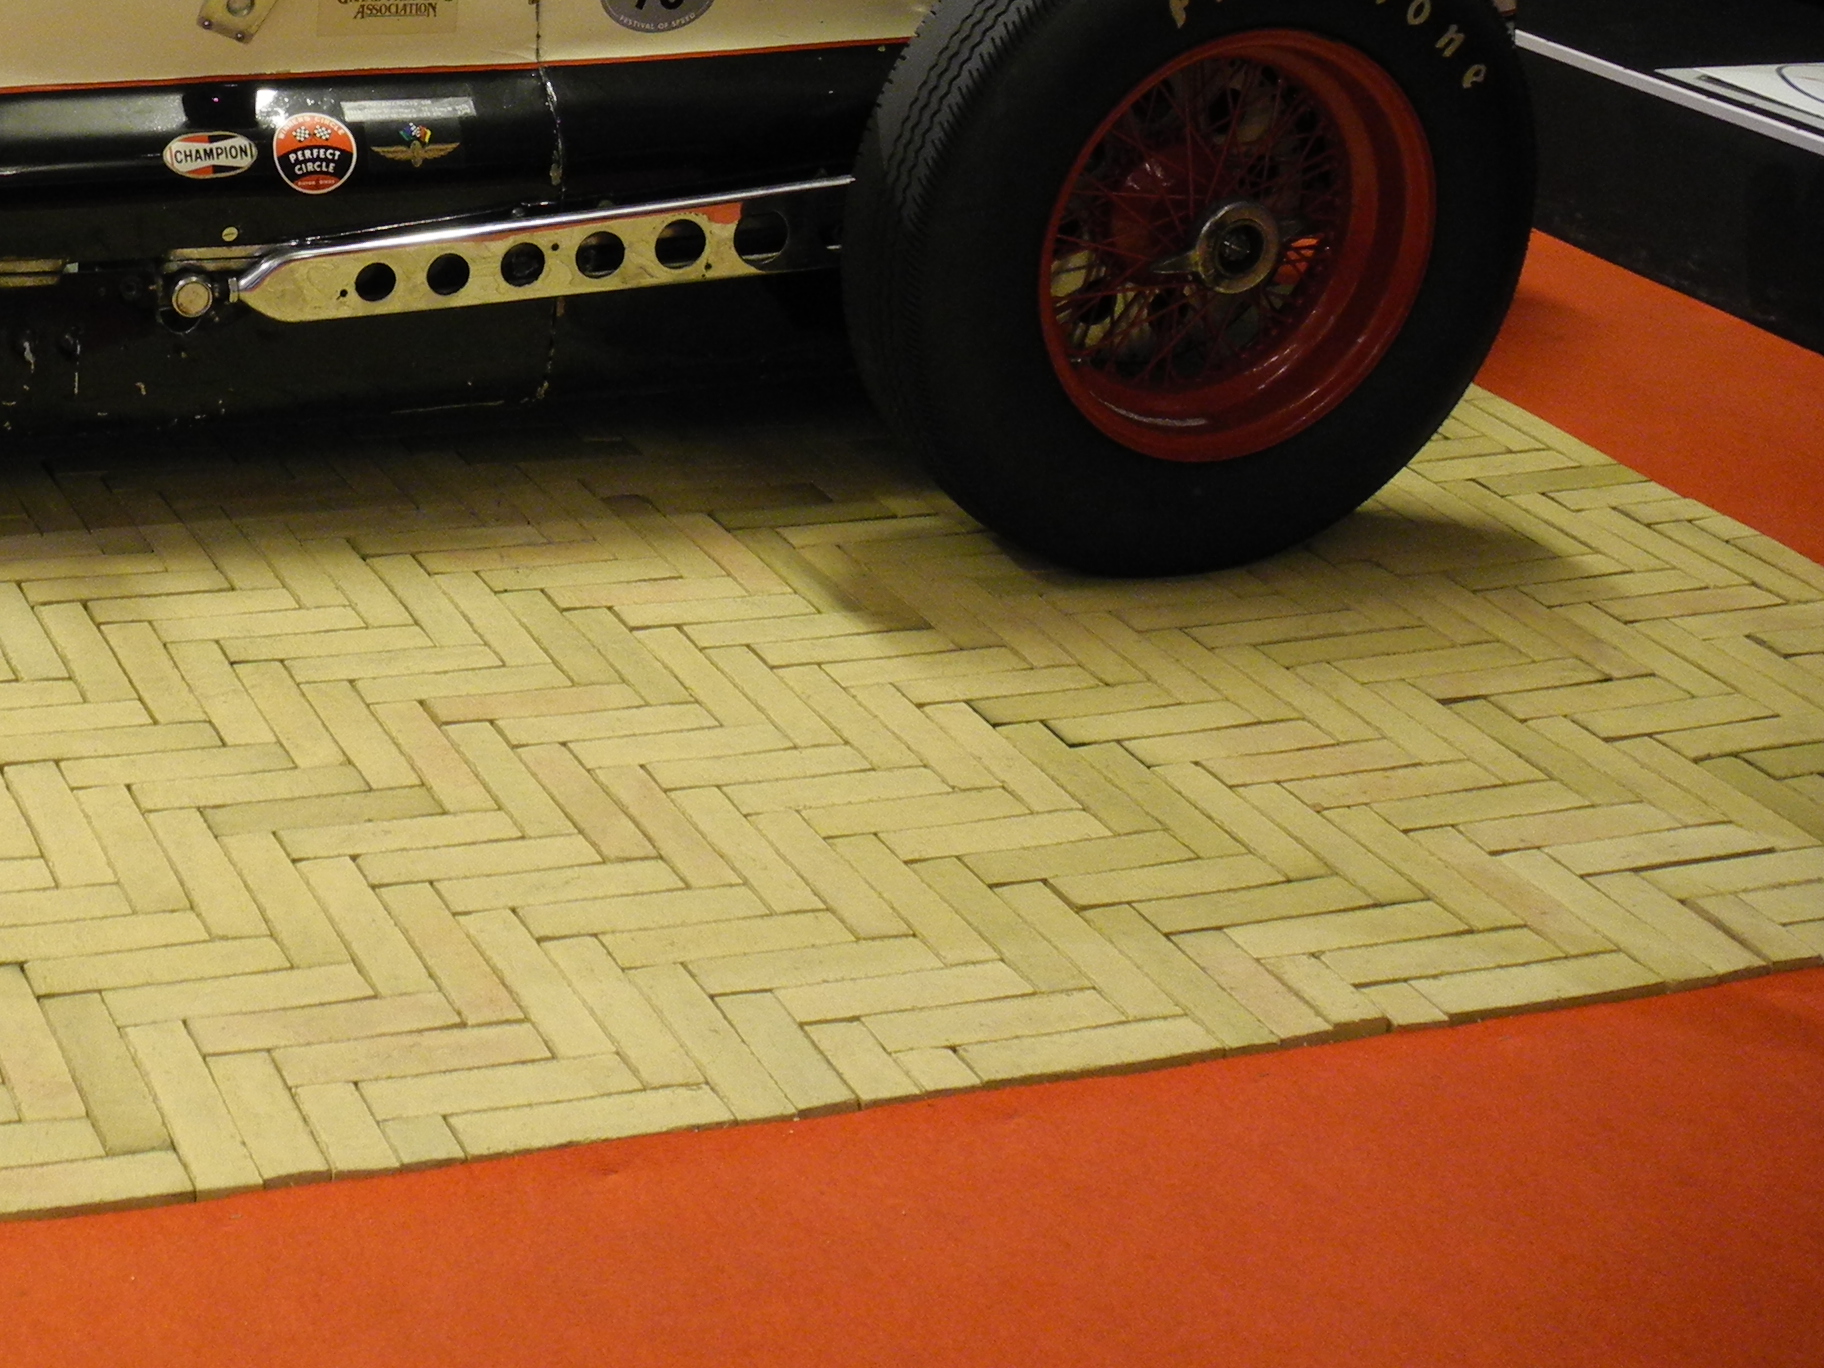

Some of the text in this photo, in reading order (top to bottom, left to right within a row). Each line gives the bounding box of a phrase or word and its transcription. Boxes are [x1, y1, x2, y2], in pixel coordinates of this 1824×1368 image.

[353, 2, 438, 19] ASSOCIATION
[619, 12, 696, 30] FESTIVAL OF SPEED
[174, 144, 249, 164] CHAMPION
[288, 148, 341, 164] PERFECT
[294, 161, 336, 175] CIRCLE
